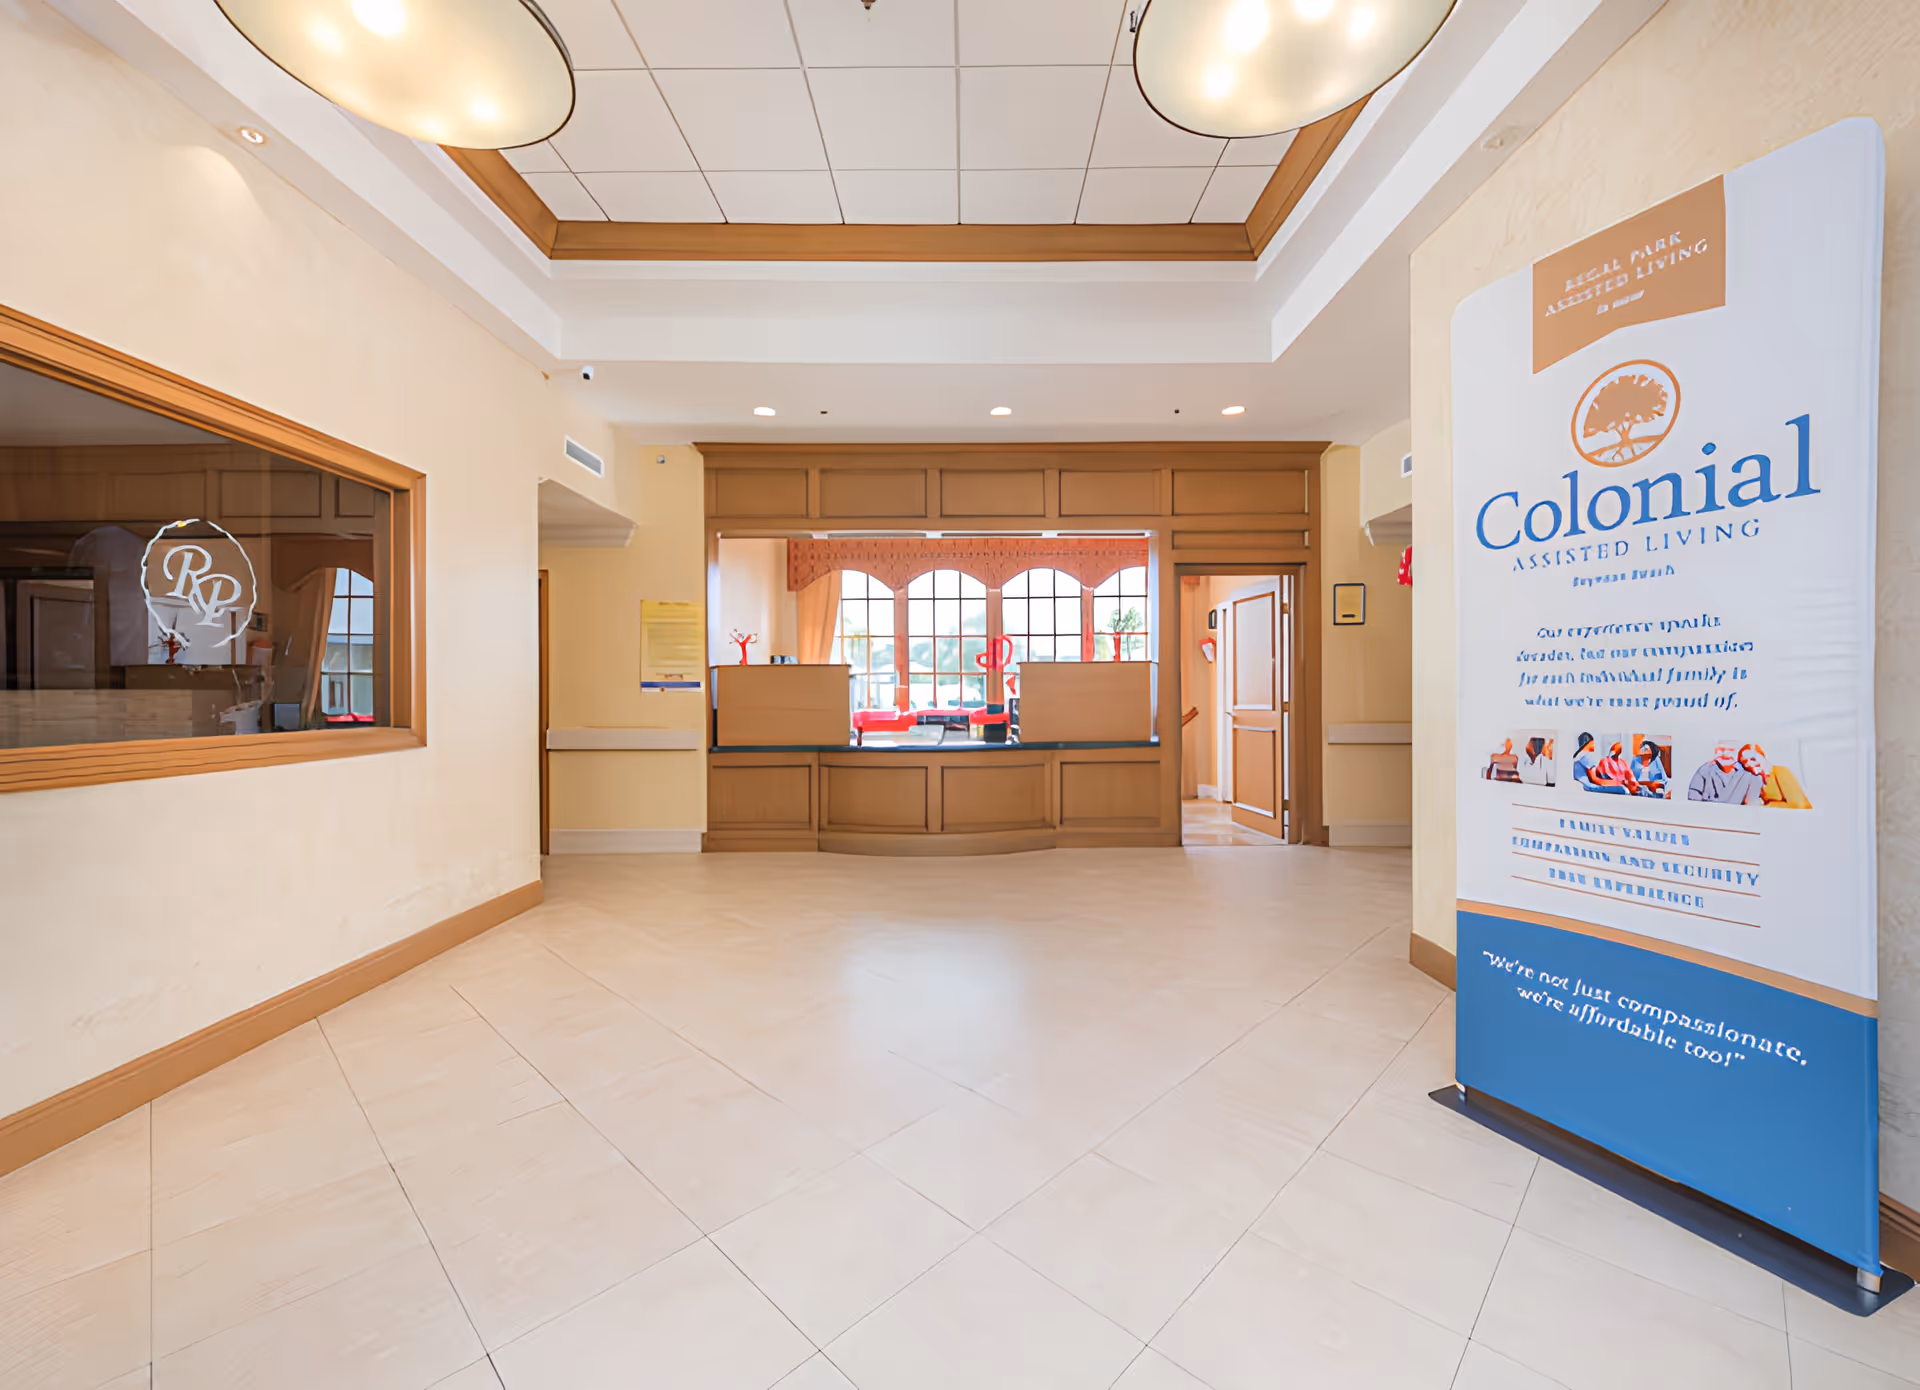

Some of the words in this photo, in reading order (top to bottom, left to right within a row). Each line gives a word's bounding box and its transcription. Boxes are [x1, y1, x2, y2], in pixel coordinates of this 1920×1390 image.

[1630, 231, 1681, 265] PARK
[1545, 273, 1629, 317] ASSISTED
[1636, 238, 1708, 280] LIVING
[1475, 413, 1821, 551] Colonial
[1512, 540, 1630, 572] ASSISTED
[1646, 518, 1760, 552] LIVING
[1536, 627, 1562, 639] Our
[1666, 665, 1727, 685] family
[1619, 855, 1656, 870] AND
[1662, 862, 1760, 887] SECURITY
[1538, 971, 1569, 991] not
[1572, 977, 1612, 1004] just
[1516, 986, 1565, 1013] we're
[1568, 1003, 1677, 1050] affordable
